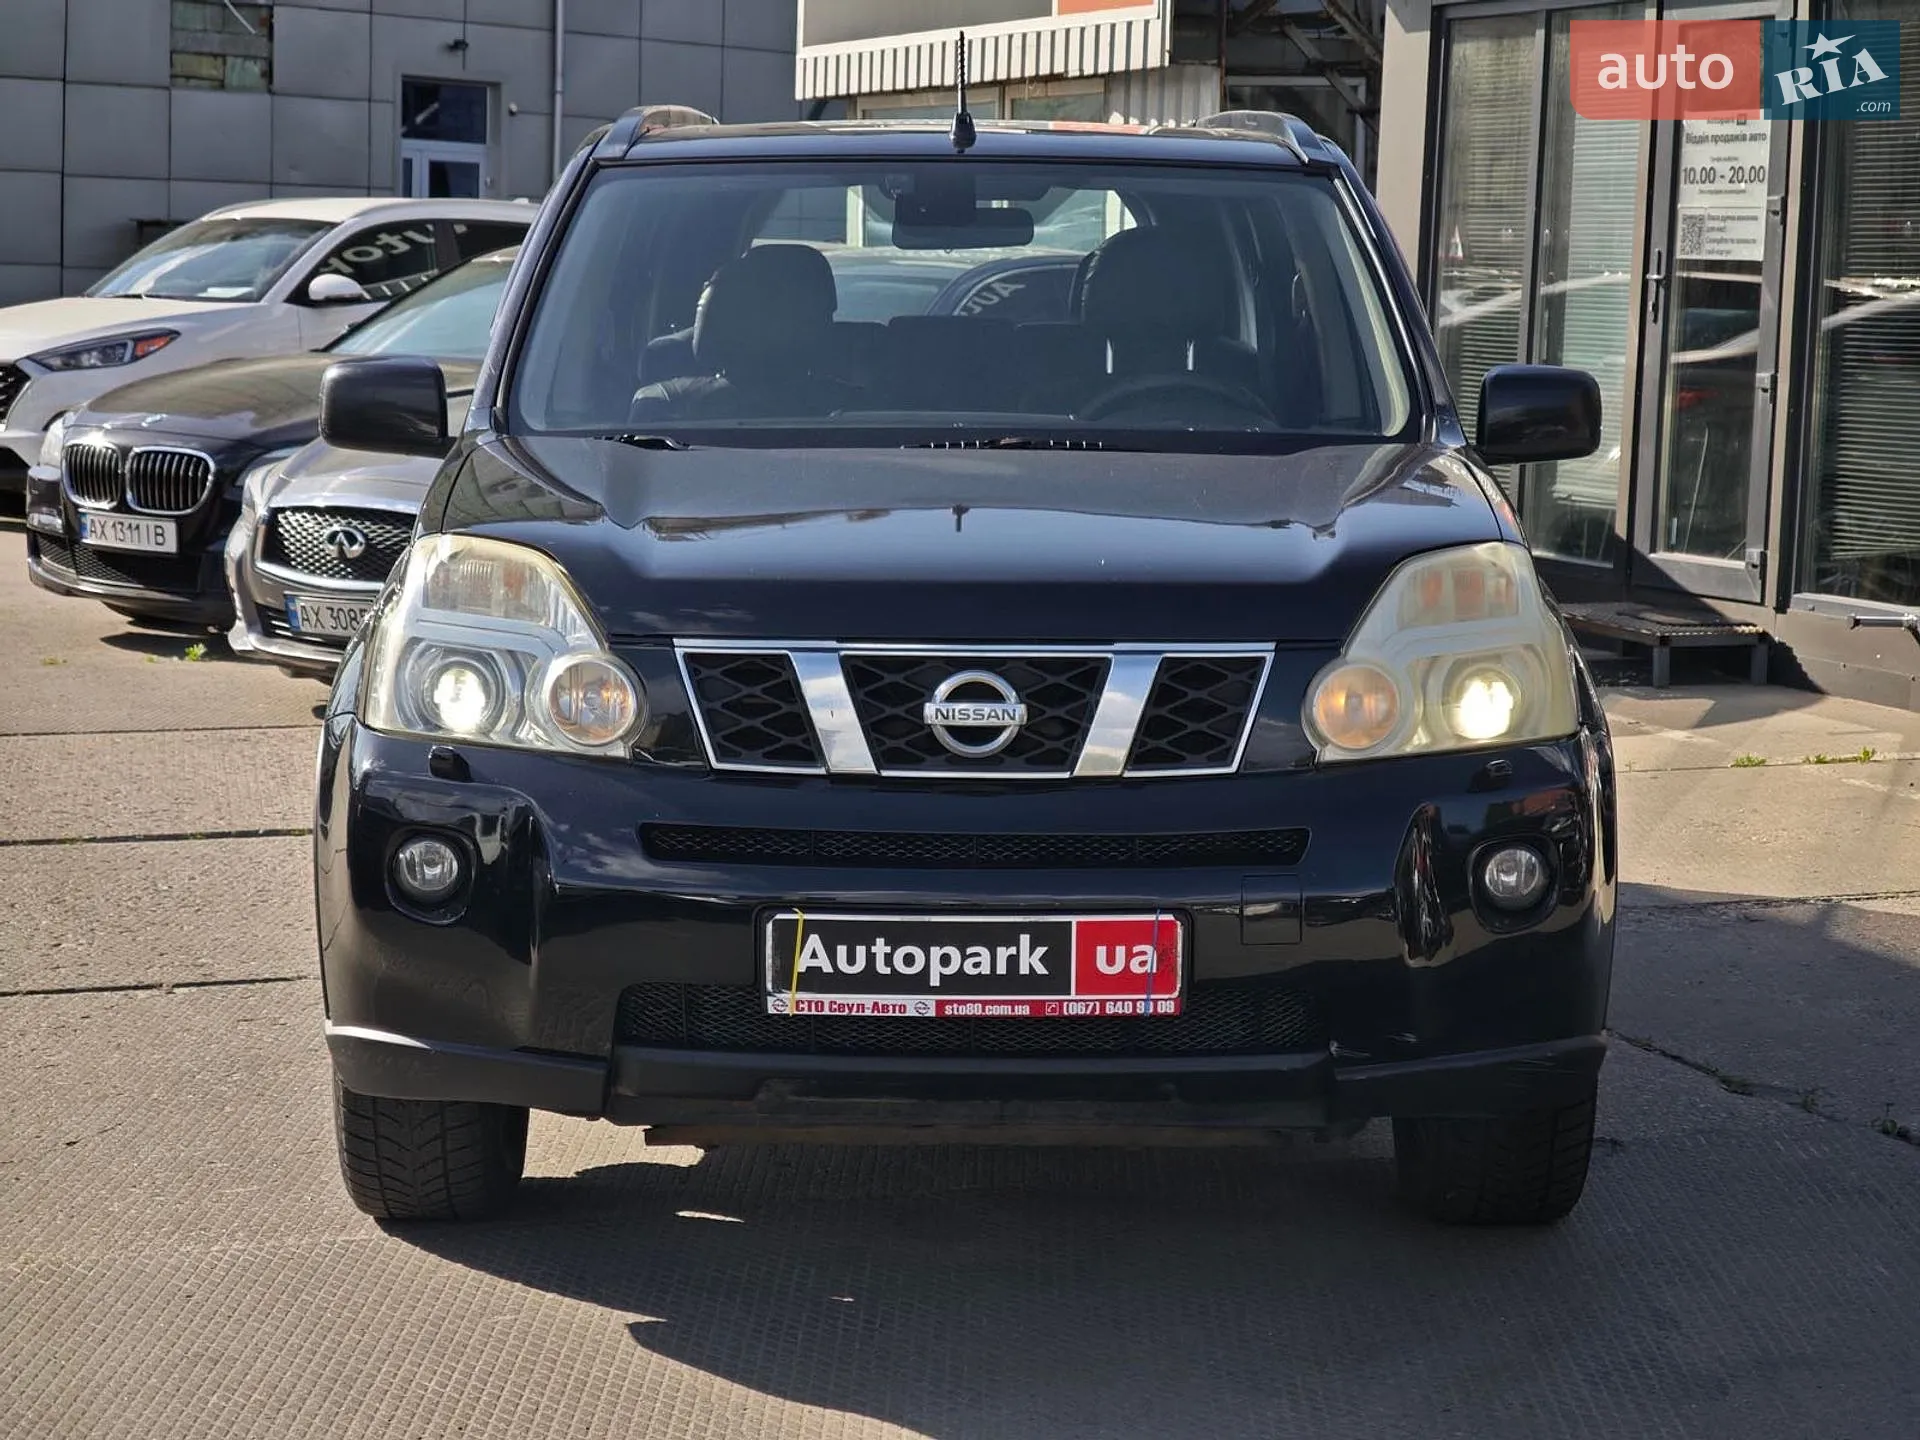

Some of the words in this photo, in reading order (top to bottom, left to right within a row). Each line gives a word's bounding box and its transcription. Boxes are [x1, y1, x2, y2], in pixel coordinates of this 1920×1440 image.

[1683, 167, 1716, 185] 10.00
[1728, 165, 1766, 184] 20.00
[301, 605, 326, 629] AX
[935, 707, 1017, 721] NISSAN
[797, 934, 1049, 987] Autopark
[1096, 944, 1157, 975] ua
[795, 1000, 825, 1013] СТО
[829, 1000, 907, 1015] Сеул-Авто
[945, 1002, 1030, 1016] sto80.com.ua
[1063, 1001, 1100, 1015] (067)
[1105, 1000, 1133, 1014] 640
